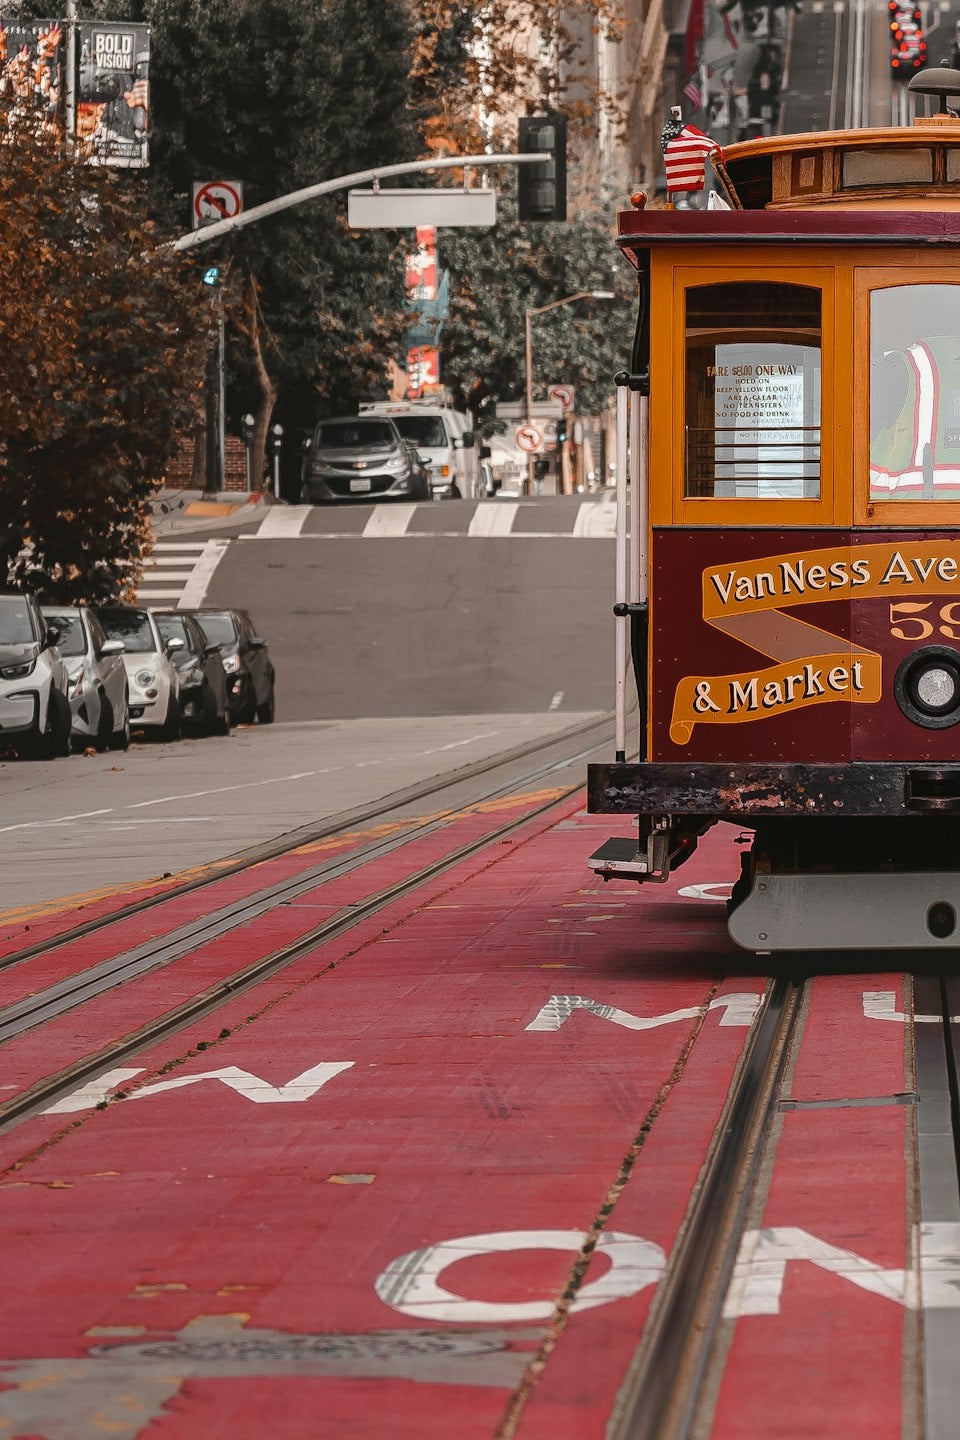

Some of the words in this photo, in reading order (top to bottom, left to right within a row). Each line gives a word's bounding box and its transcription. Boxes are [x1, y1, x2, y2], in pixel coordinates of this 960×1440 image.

[96, 33, 133, 54] BOLD
[96, 54, 131, 69] VISION
[706, 365, 729, 377] FARE
[755, 365, 775, 376] ONE
[778, 365, 798, 376] WAY
[693, 680, 722, 714] &
[726, 659, 864, 714] Market
